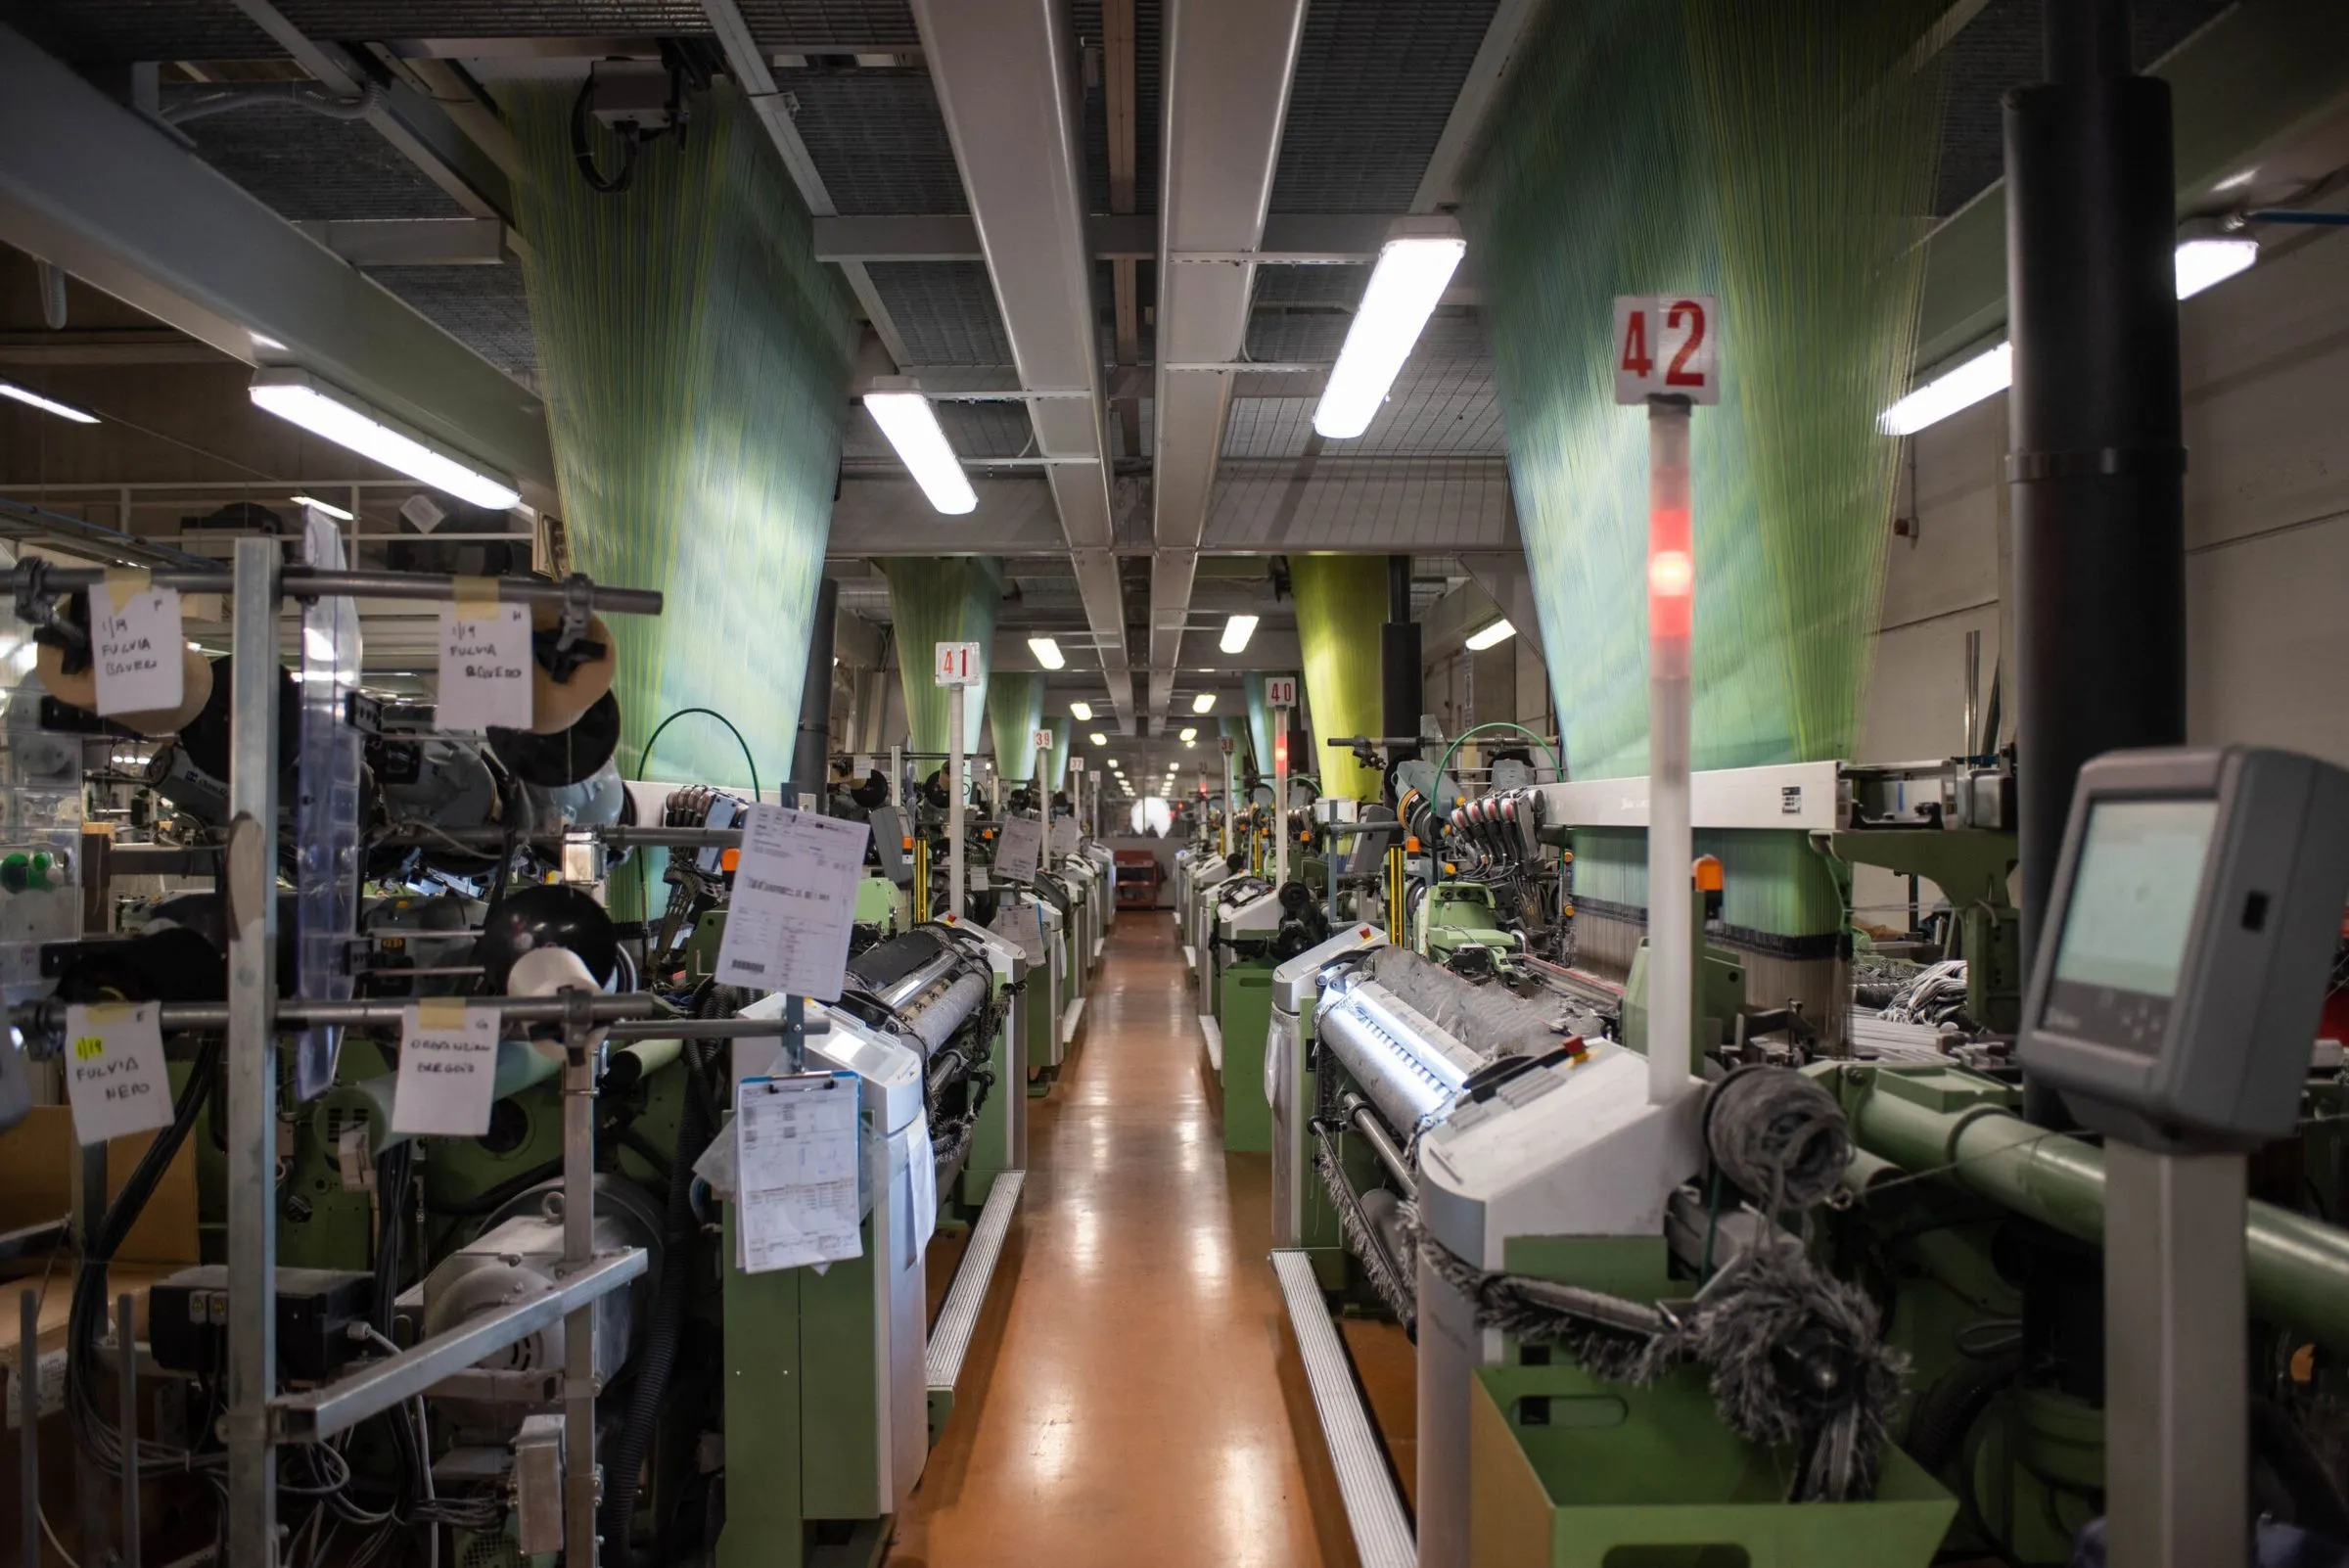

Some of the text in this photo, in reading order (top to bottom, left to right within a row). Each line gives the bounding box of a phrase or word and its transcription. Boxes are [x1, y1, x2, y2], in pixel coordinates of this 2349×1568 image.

[1622, 300, 1705, 388] 42
[102, 637, 151, 657] FULVIA
[450, 644, 497, 657] FULVIA
[943, 648, 967, 677] 41
[1271, 682, 1292, 702] 40
[76, 1057, 139, 1082] FULVIA
